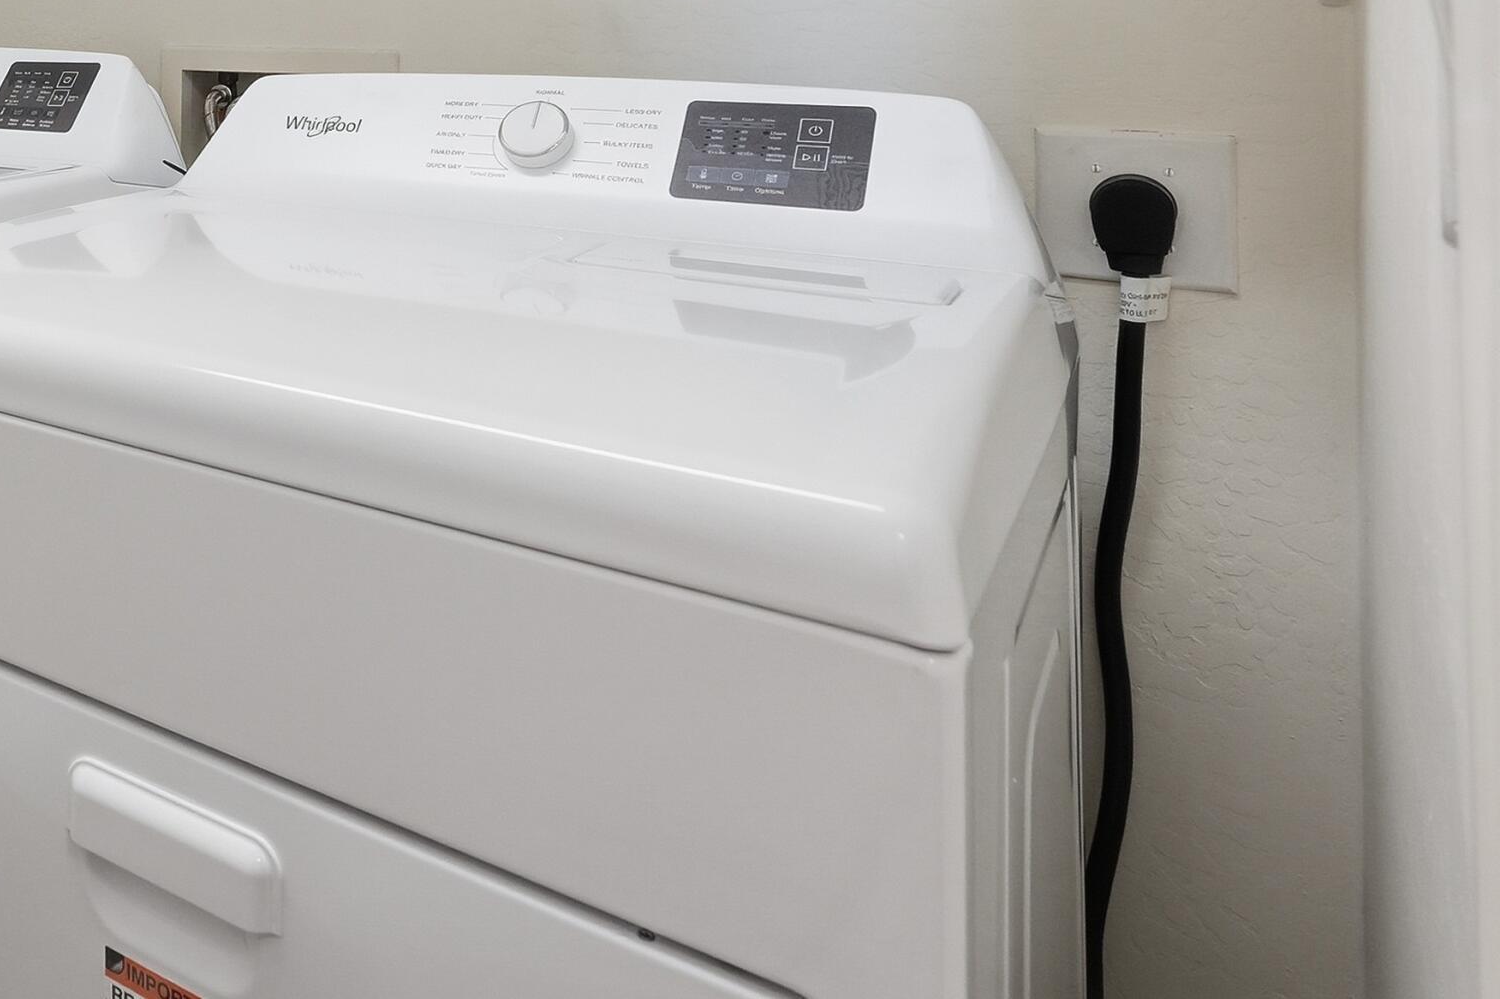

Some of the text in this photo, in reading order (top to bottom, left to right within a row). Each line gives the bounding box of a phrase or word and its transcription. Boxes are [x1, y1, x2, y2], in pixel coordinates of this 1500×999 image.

[286, 115, 363, 137] Whirlpool
[615, 122, 659, 130] DELICATES
[616, 160, 650, 169] TOWELS
[606, 175, 645, 184] CONTROL
